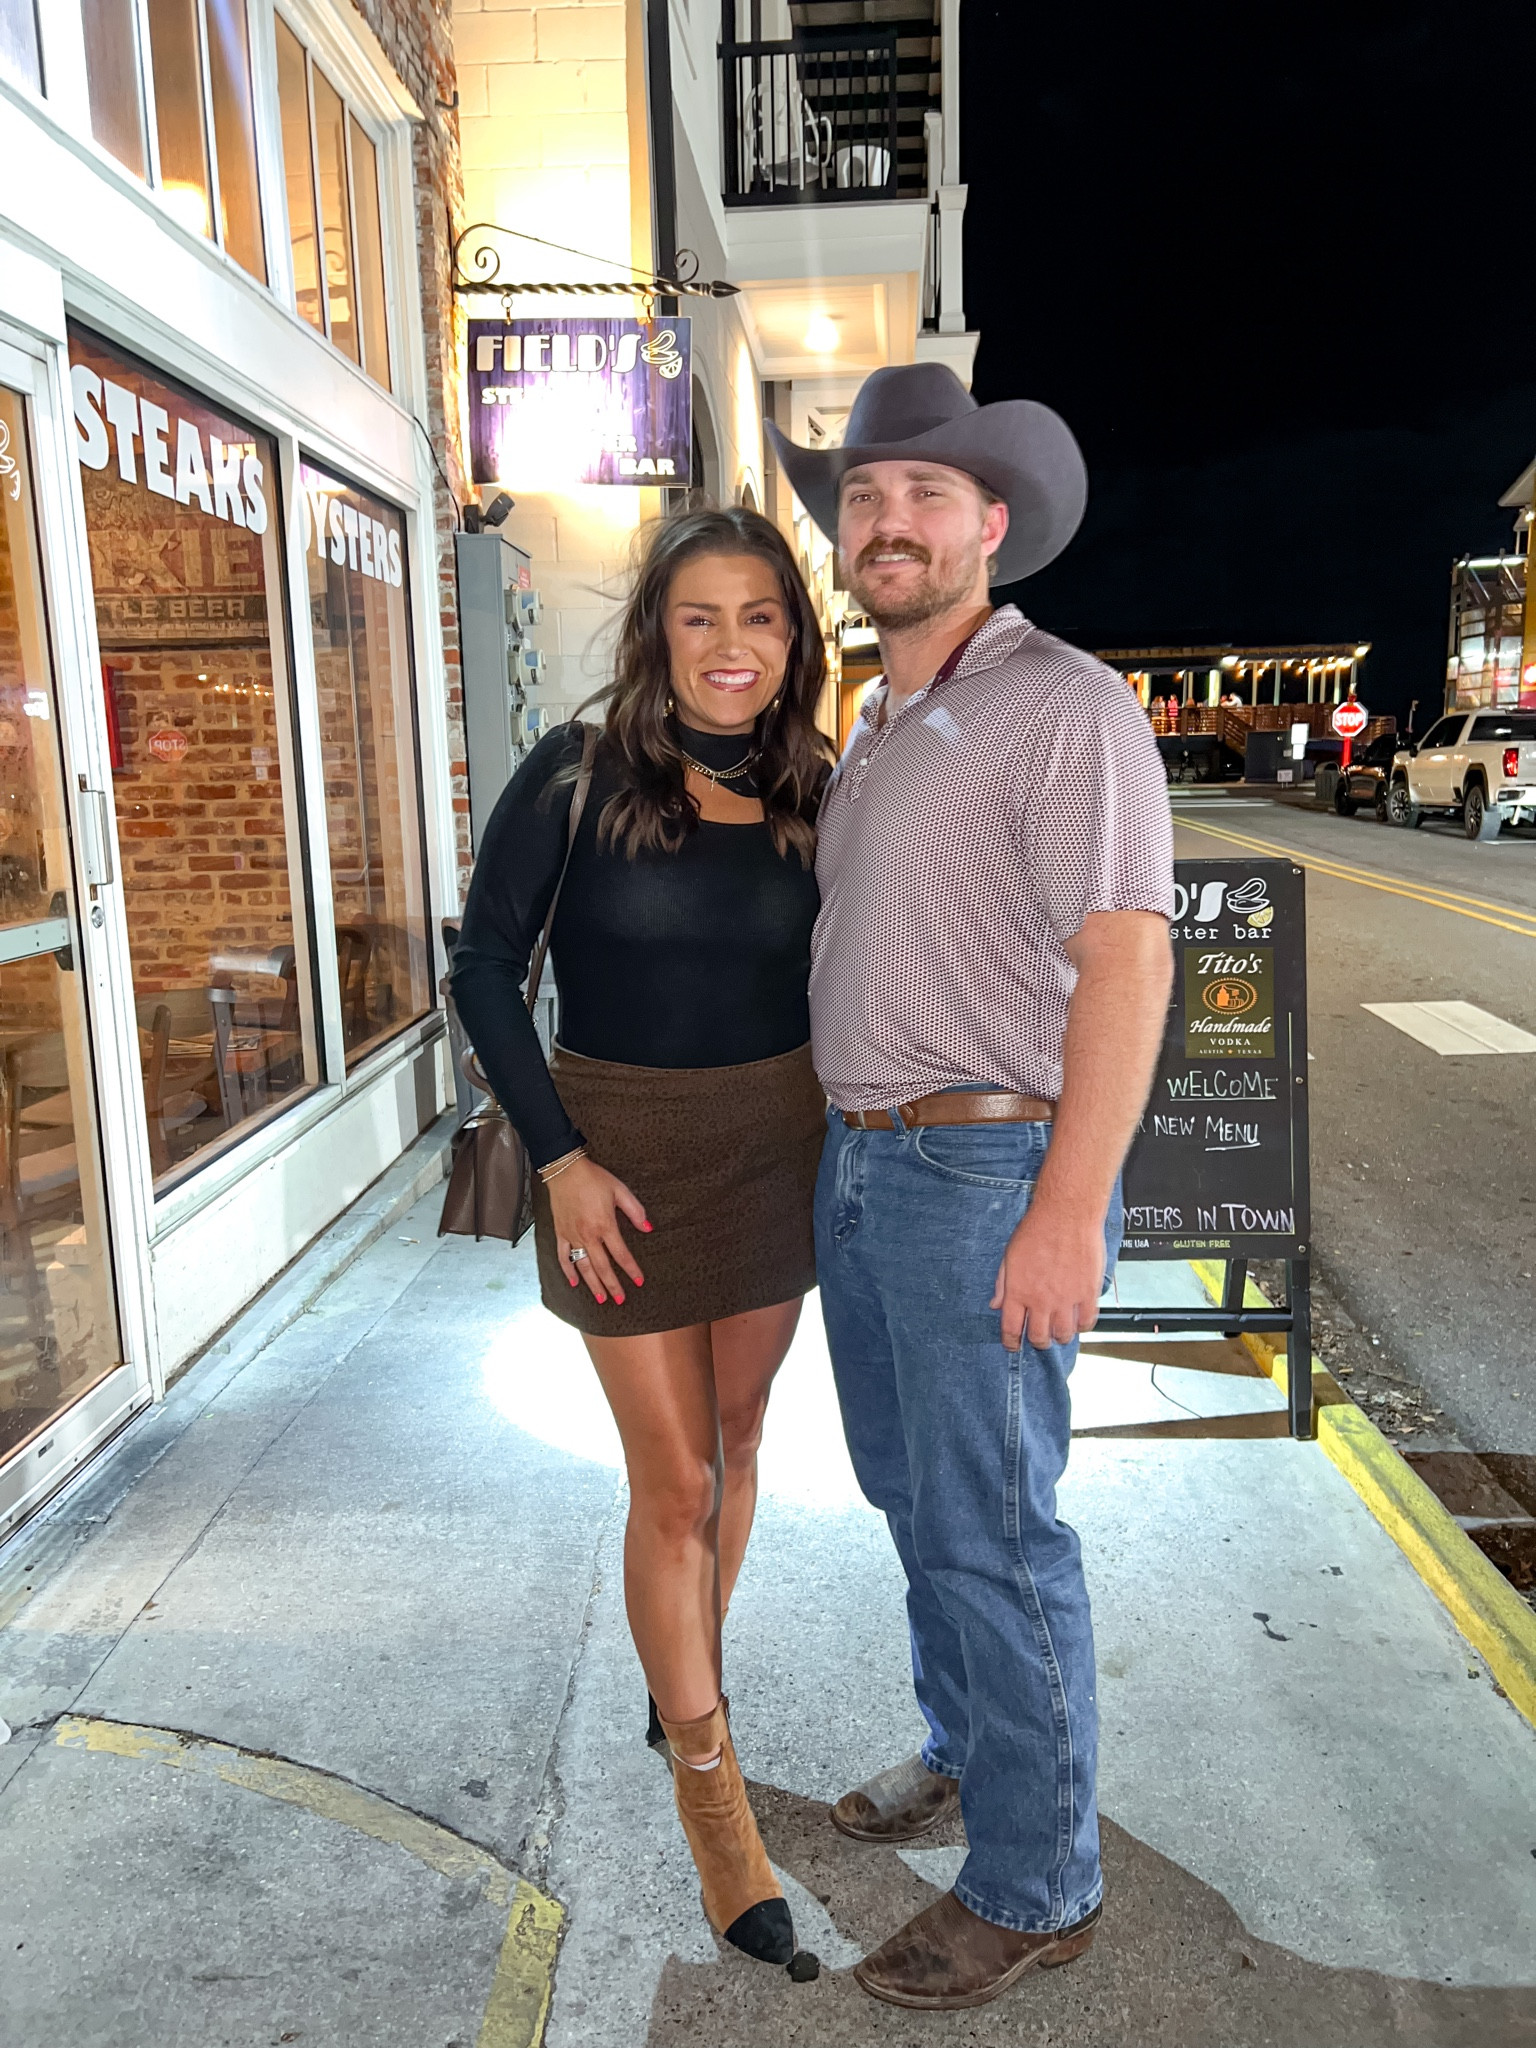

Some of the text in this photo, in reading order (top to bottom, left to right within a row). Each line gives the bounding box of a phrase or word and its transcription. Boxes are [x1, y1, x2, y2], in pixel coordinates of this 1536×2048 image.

[476, 334, 641, 373] FIELD'S
[71, 364, 268, 535] STEAKS
[619, 458, 675, 475] BAR
[169, 599, 245, 619] BEER
[1335, 712, 1364, 727] STOP
[1233, 924, 1272, 940] bar
[1197, 951, 1262, 975] Tito's
[1190, 1016, 1271, 1034] Handmade
[1210, 1038, 1251, 1046] VODKA
[1154, 1114, 1195, 1136] NEW
[1205, 1115, 1258, 1143] MENU
[1123, 1203, 1294, 1233] YSTERS IN TOWN
[1173, 1240, 1206, 1249] GLUTEN
[1208, 1240, 1231, 1248] FREE
